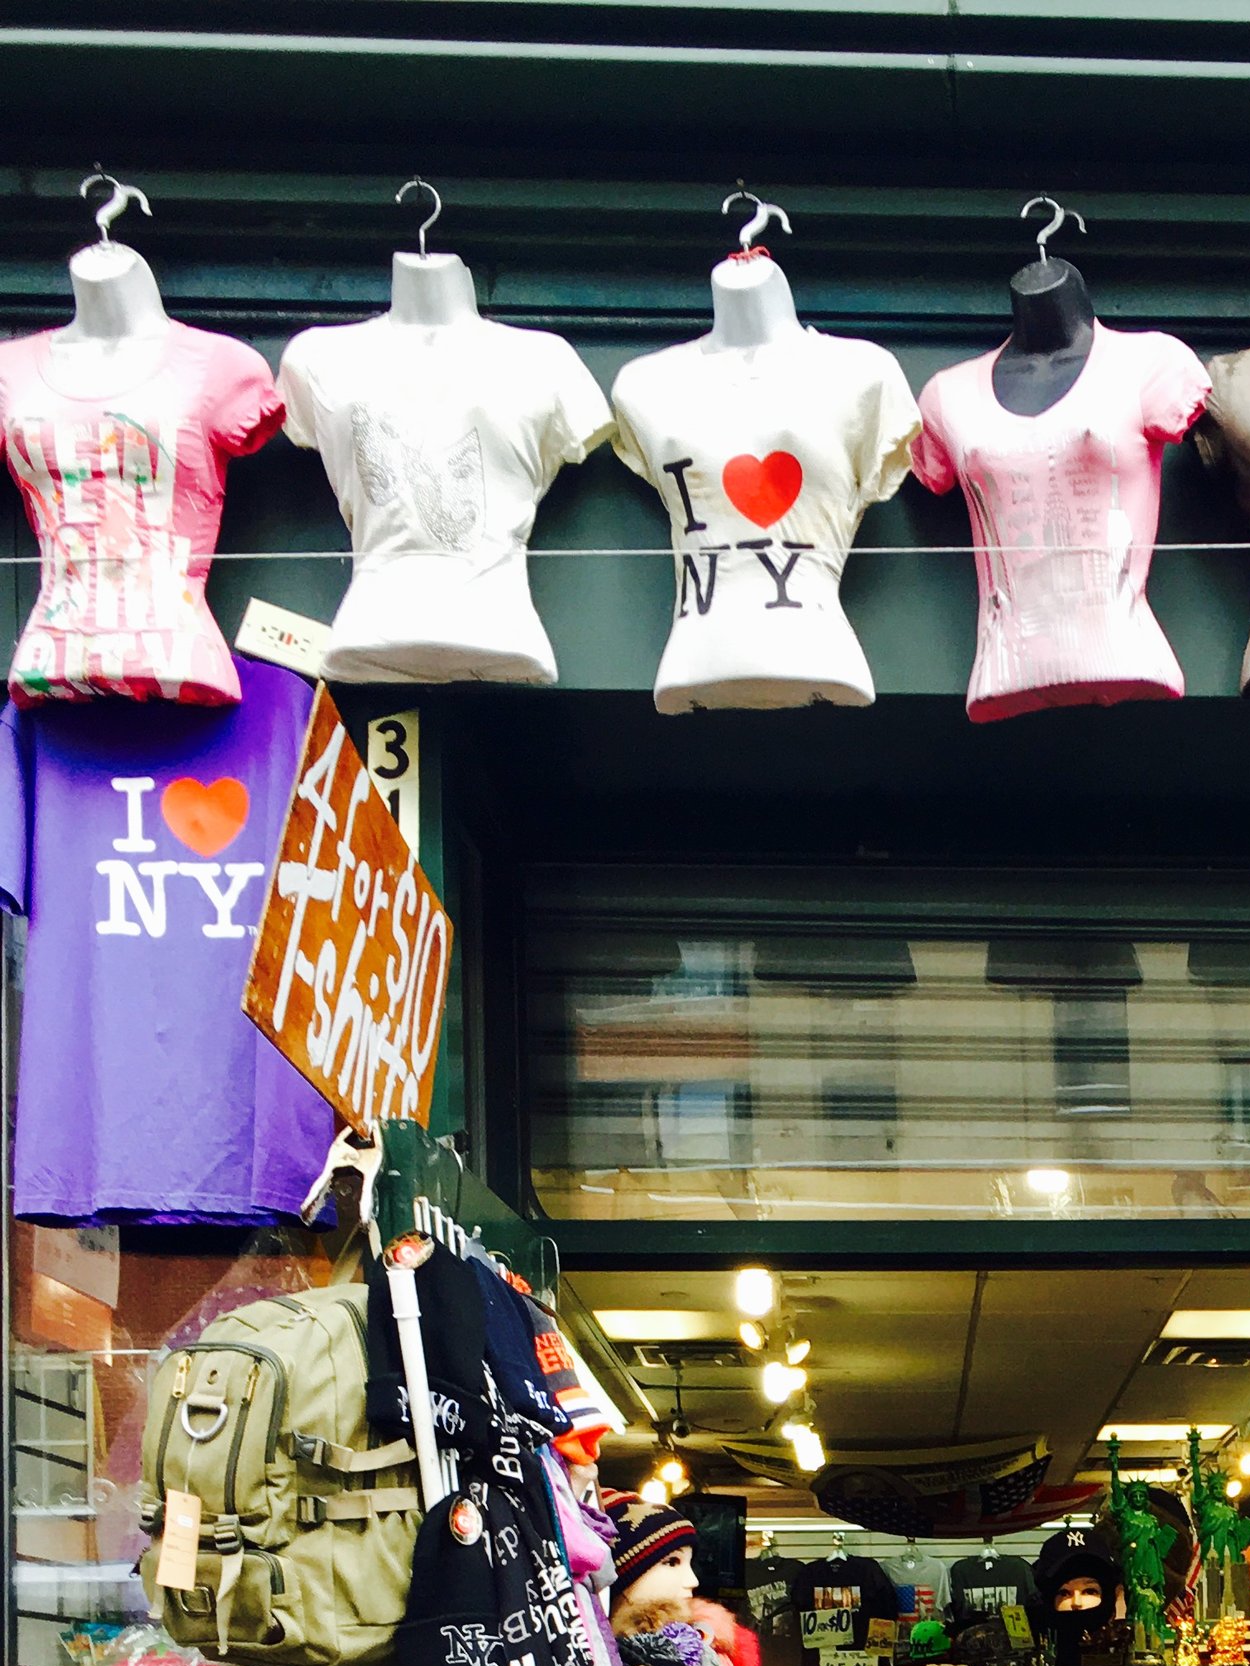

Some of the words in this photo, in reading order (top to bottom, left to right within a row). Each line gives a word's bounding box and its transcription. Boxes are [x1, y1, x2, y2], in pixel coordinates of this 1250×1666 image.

[663, 457, 707, 535] I
[677, 537, 816, 618] NY
[110, 777, 156, 852] I
[96, 861, 264, 937] NY
[386, 848, 446, 1080] $10
[1067, 1531, 1086, 1547] NY
[803, 1612, 818, 1635] 10
